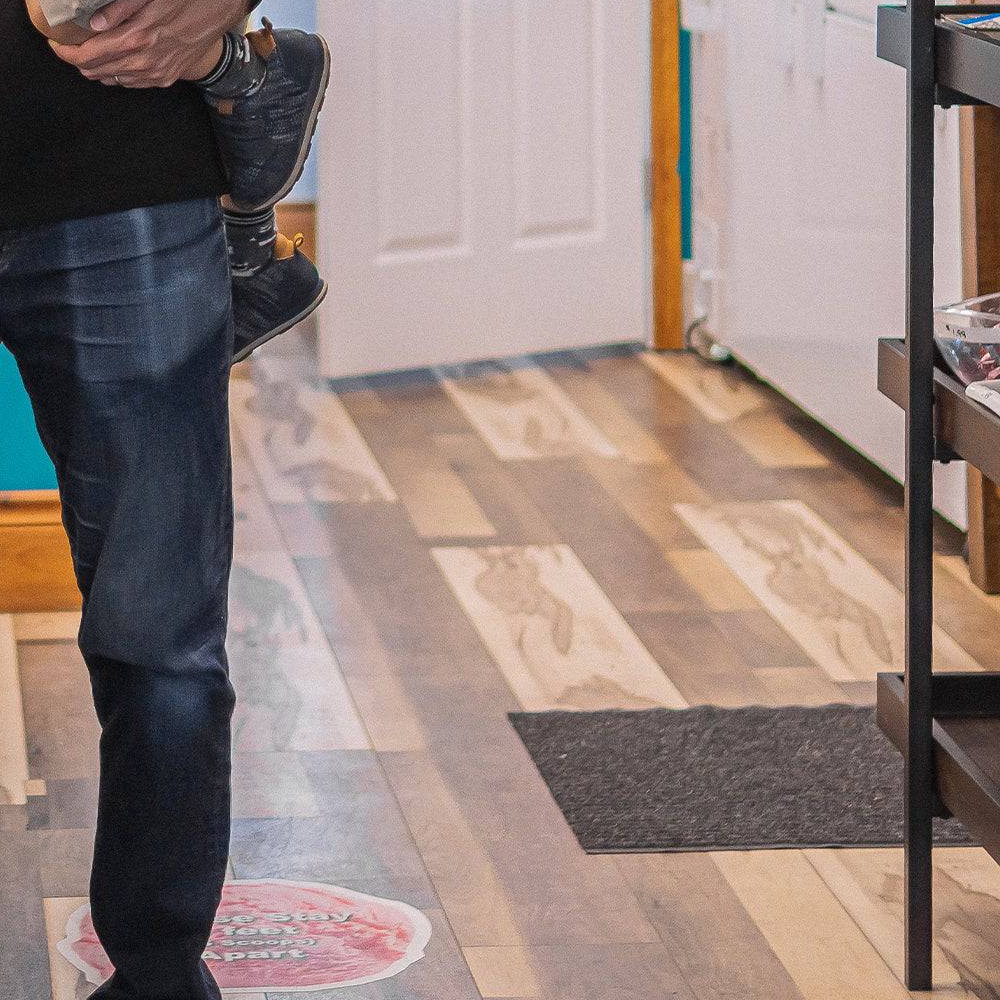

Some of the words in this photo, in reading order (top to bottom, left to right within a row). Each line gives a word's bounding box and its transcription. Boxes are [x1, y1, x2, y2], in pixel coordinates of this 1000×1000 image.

[262, 911, 354, 923] Stay
[223, 926, 301, 936] feet
[200, 950, 310, 962] Apart
